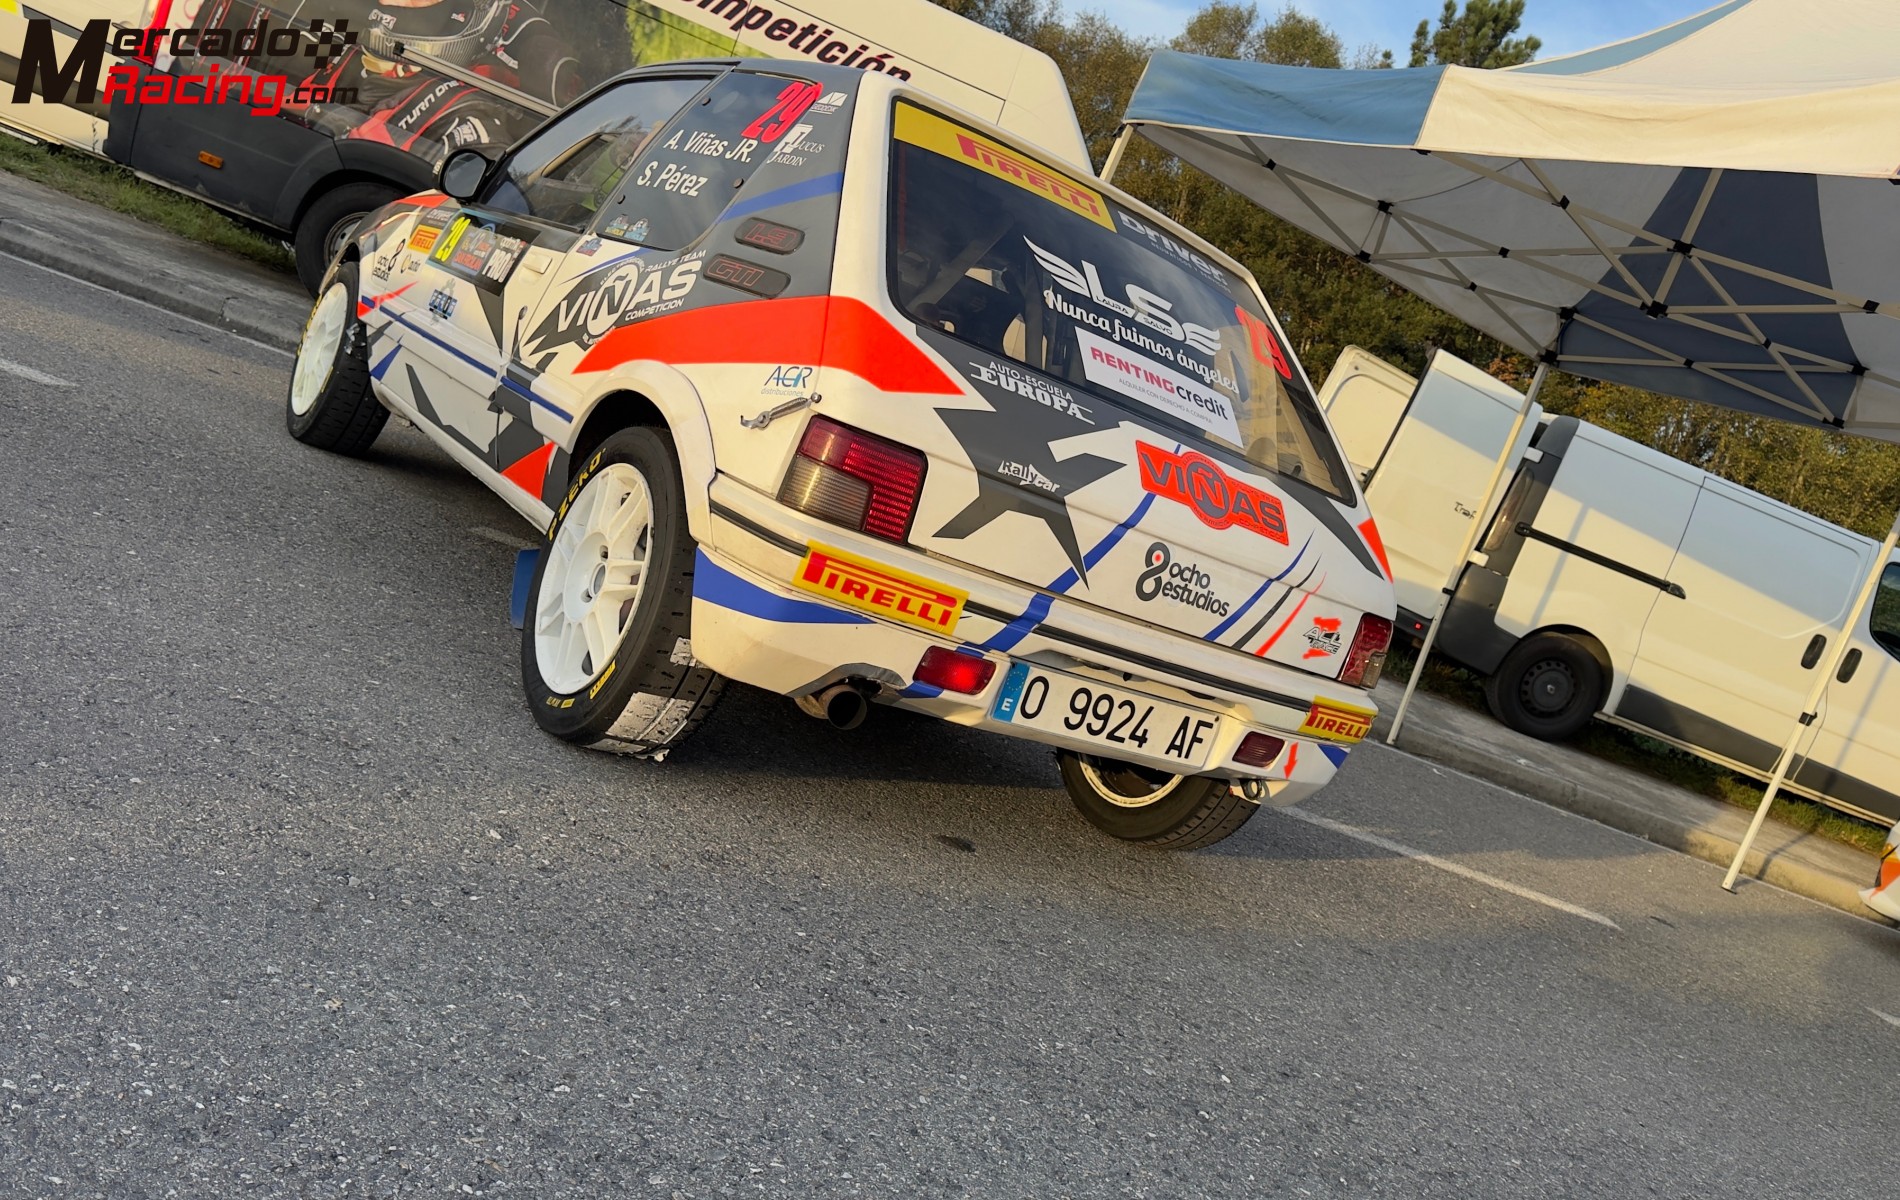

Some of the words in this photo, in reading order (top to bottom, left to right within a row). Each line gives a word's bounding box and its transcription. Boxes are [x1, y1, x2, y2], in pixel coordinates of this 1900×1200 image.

[398, 93, 435, 130] TURN
[741, 82, 824, 143] 29
[663, 130, 679, 150] A.
[683, 131, 726, 157] Viñas
[637, 160, 659, 187] S.
[654, 163, 708, 197] Pérez
[956, 133, 1101, 217] PIRELLI
[435, 216, 471, 262] 29
[680, 249, 706, 262] TEAM
[706, 257, 765, 287] GTI
[557, 260, 703, 336] VIÑAS
[1096, 297, 1129, 314] LAURA
[1043, 287, 1112, 333] Nunca
[1112, 318, 1175, 363] fuimos
[1177, 349, 1240, 395] ángeles
[1143, 317, 1173, 335] SALVO
[1234, 304, 1293, 380] 29
[969, 361, 1096, 426] EUROPA
[989, 361, 1074, 402] AUTO-ESCUELA
[1141, 452, 1284, 533] VIÑAS
[802, 551, 958, 626] PIRELLI
[1168, 561, 1211, 590] ocho
[1161, 583, 1230, 618] estudios
[1000, 697, 1014, 712] E
[1063, 686, 1157, 749] 9924
[1165, 715, 1216, 761] AF
[1306, 705, 1369, 740] PIRELLI
